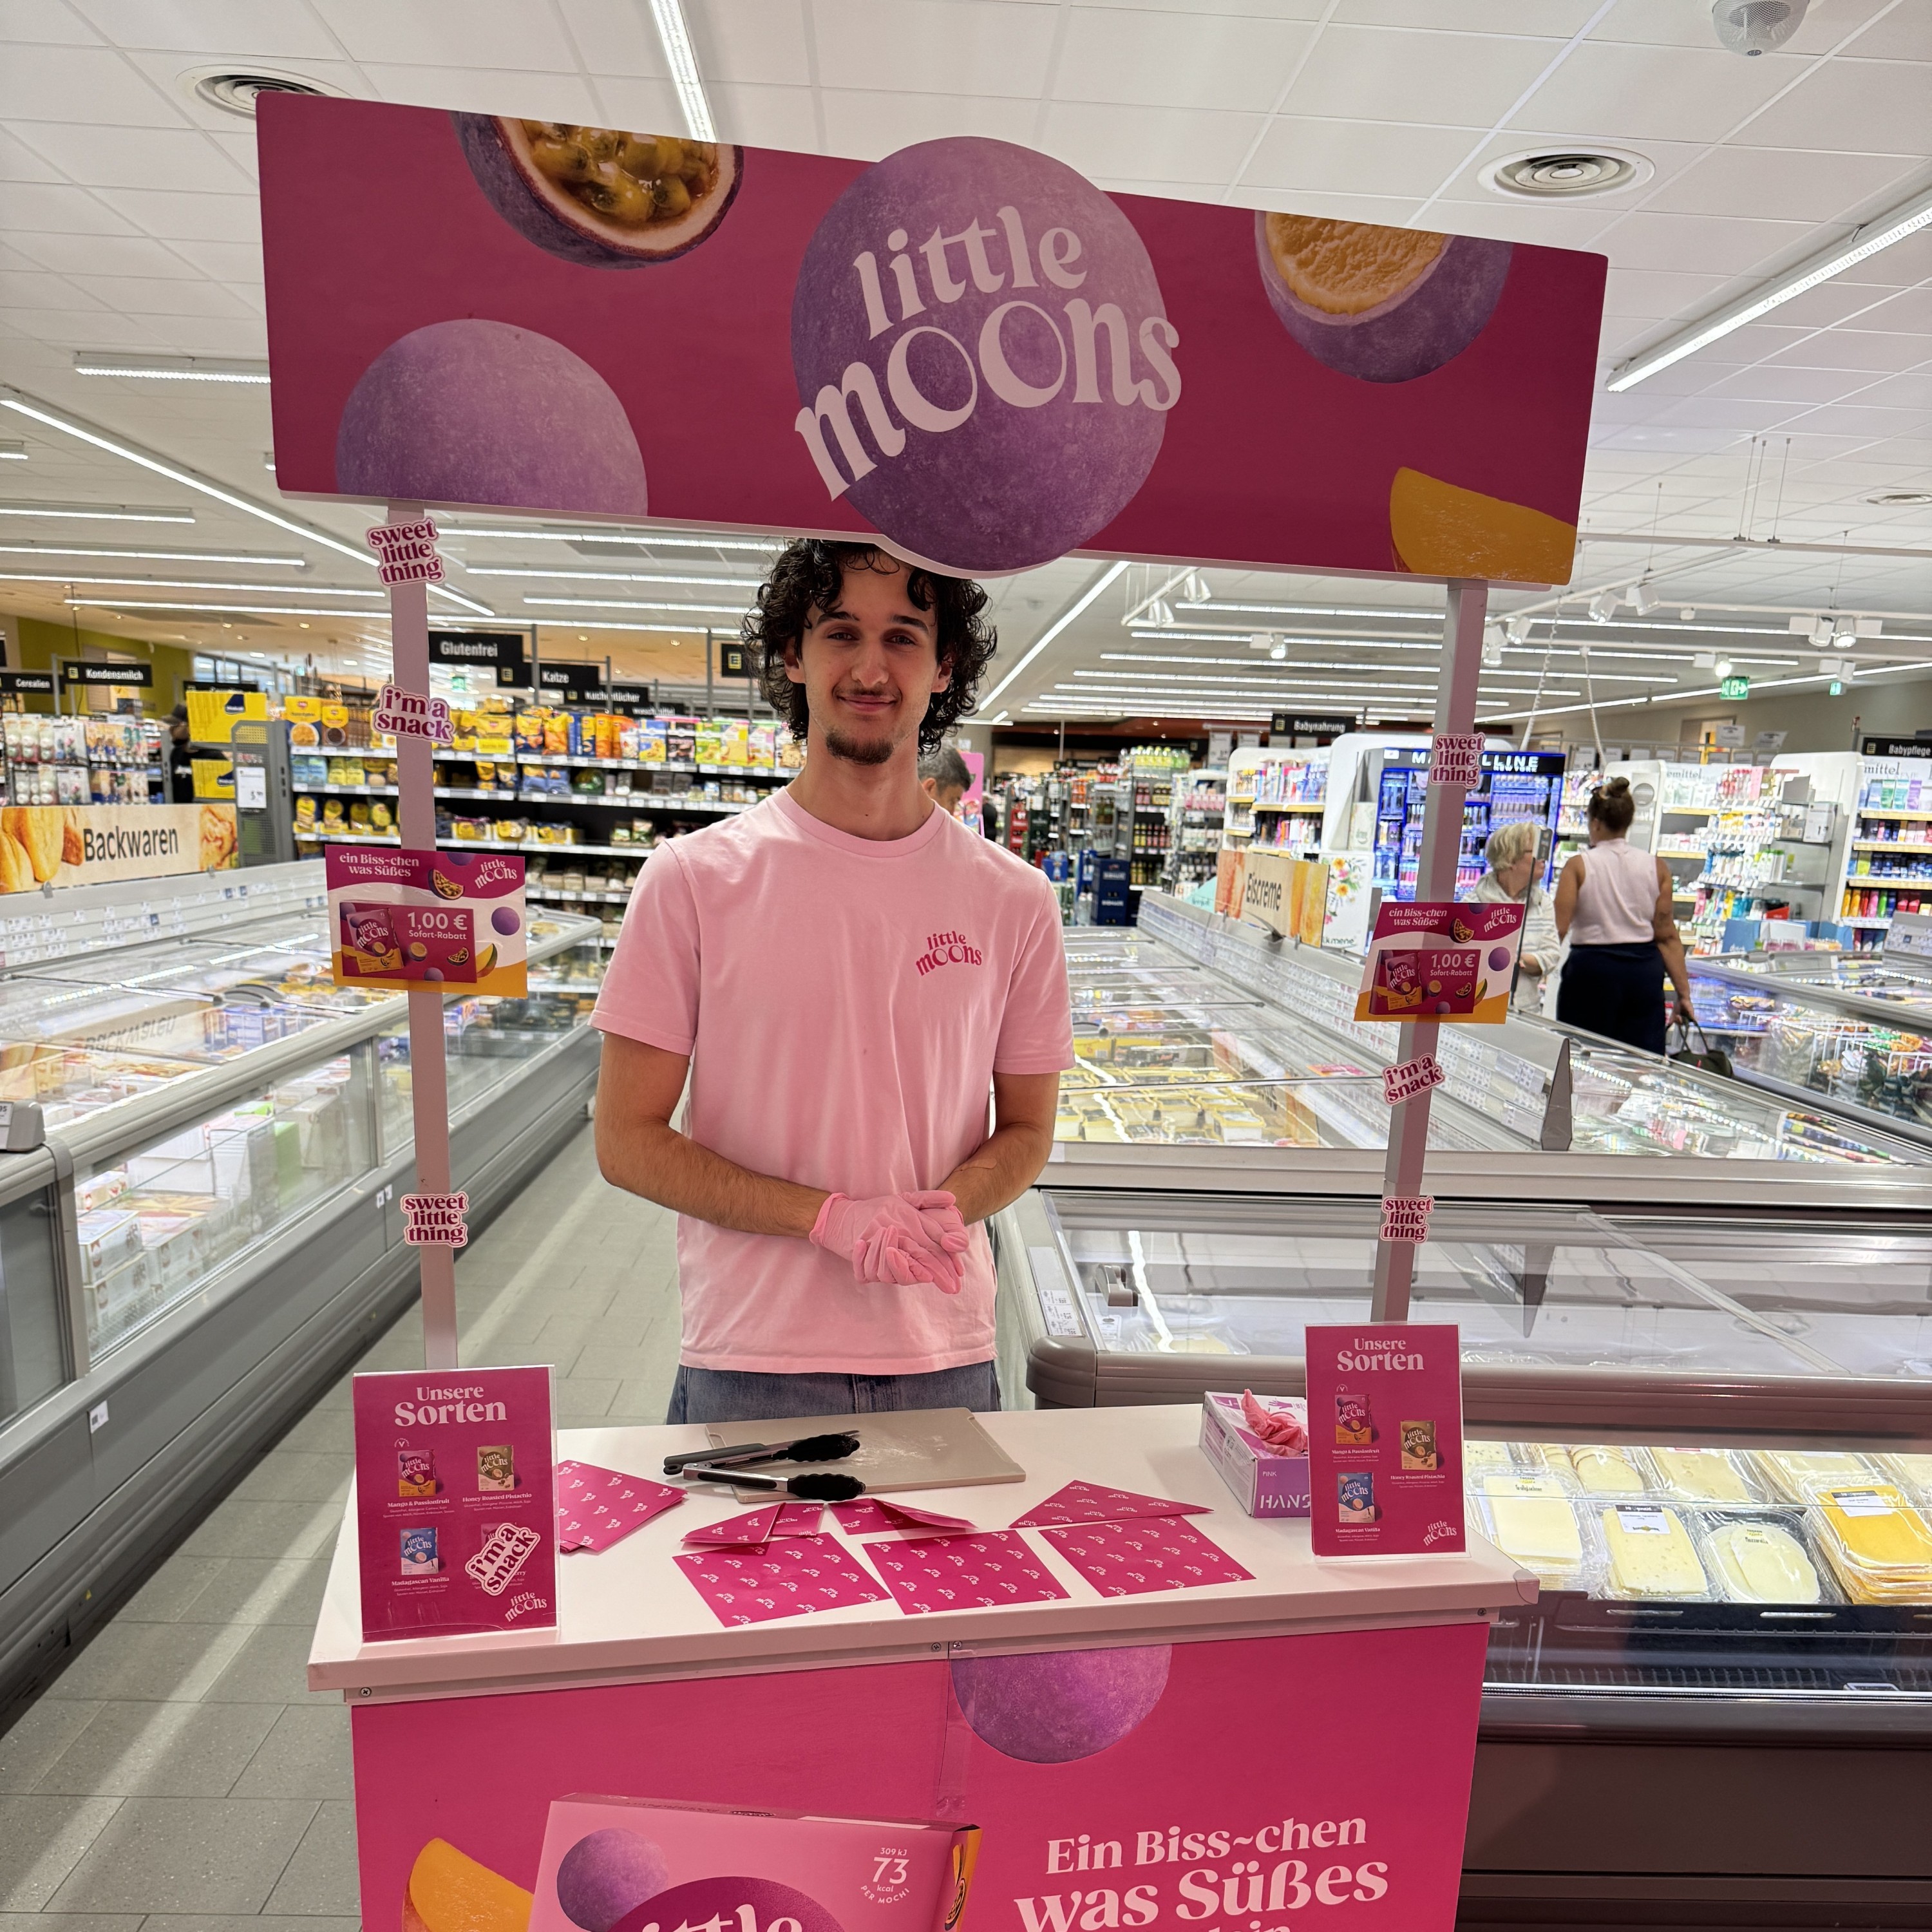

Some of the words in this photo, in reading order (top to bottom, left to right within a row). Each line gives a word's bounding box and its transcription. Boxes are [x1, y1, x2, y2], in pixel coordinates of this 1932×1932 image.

[853, 206, 1087, 340] little
[795, 298, 1181, 502] moons
[370, 521, 435, 545] sweet
[382, 542, 431, 564] little
[381, 559, 442, 583] thing
[440, 641, 498, 657] Glutenfrei
[86, 668, 143, 681] Kondensmilch
[542, 671, 569, 684] Katze
[385, 689, 426, 715] i'm
[431, 703, 445, 719] a
[377, 714, 450, 739] snack
[1294, 719, 1345, 734] Babynahrung
[1435, 736, 1484, 750] sweet
[1888, 743, 1931, 757] Babypflege
[1437, 750, 1475, 766] little
[1433, 765, 1479, 784] thing
[83, 826, 178, 862] Backwaren
[339, 853, 358, 864] ein
[480, 858, 506, 873] little
[348, 865, 372, 875] was
[374, 865, 411, 877] Süßes
[475, 868, 517, 889] moons
[1246, 871, 1282, 911] Eiscreme
[1389, 908, 1403, 917] ein
[1491, 907, 1510, 919] little
[358, 920, 377, 934] little
[407, 912, 449, 929] 1,00
[453, 914, 468, 931] €
[1412, 917, 1439, 926] Süßes
[1484, 913, 1517, 933] moons
[408, 929, 467, 940] Sofort-Rabatt
[927, 931, 967, 951] little
[916, 945, 982, 976] moons
[1431, 954, 1461, 969] 1,00
[1464, 953, 1476, 967] €
[1392, 964, 1408, 977] little
[1386, 1063, 1419, 1085] i'm
[1422, 1057, 1433, 1070] a
[1388, 1069, 1442, 1101] snack
[405, 1196, 464, 1209] sweet
[1385, 1199, 1432, 1211] sweet
[413, 1210, 458, 1225] little
[1390, 1211, 1424, 1224] little
[409, 1226, 464, 1243] thing
[1384, 1225, 1426, 1241] thing
[1354, 1338, 1406, 1350] Unsere
[1337, 1350, 1424, 1372] Sorten
[417, 1387, 484, 1401] Unsere
[394, 1400, 507, 1426] Sorten
[1341, 1402, 1358, 1413] little
[1407, 1429, 1423, 1439] little
[405, 1458, 422, 1468] little
[484, 1454, 500, 1464] little
[1345, 1481, 1361, 1491] little
[1428, 1520, 1448, 1532] little
[407, 1536, 424, 1546] little
[1423, 1526, 1457, 1546] moons
[471, 1542, 506, 1577] i'm
[501, 1528, 516, 1542] a
[488, 1531, 535, 1590] snack
[511, 1591, 535, 1606] little
[505, 1596, 547, 1622] moons
[1046, 1834, 1122, 1874] Ein
[873, 1857, 909, 1884] 73
[860, 1885, 875, 1900] PER
[878, 1888, 909, 1904] MOCHI
[1014, 1885, 1159, 1932] was
[1176, 1860, 1388, 1920] Süßes
